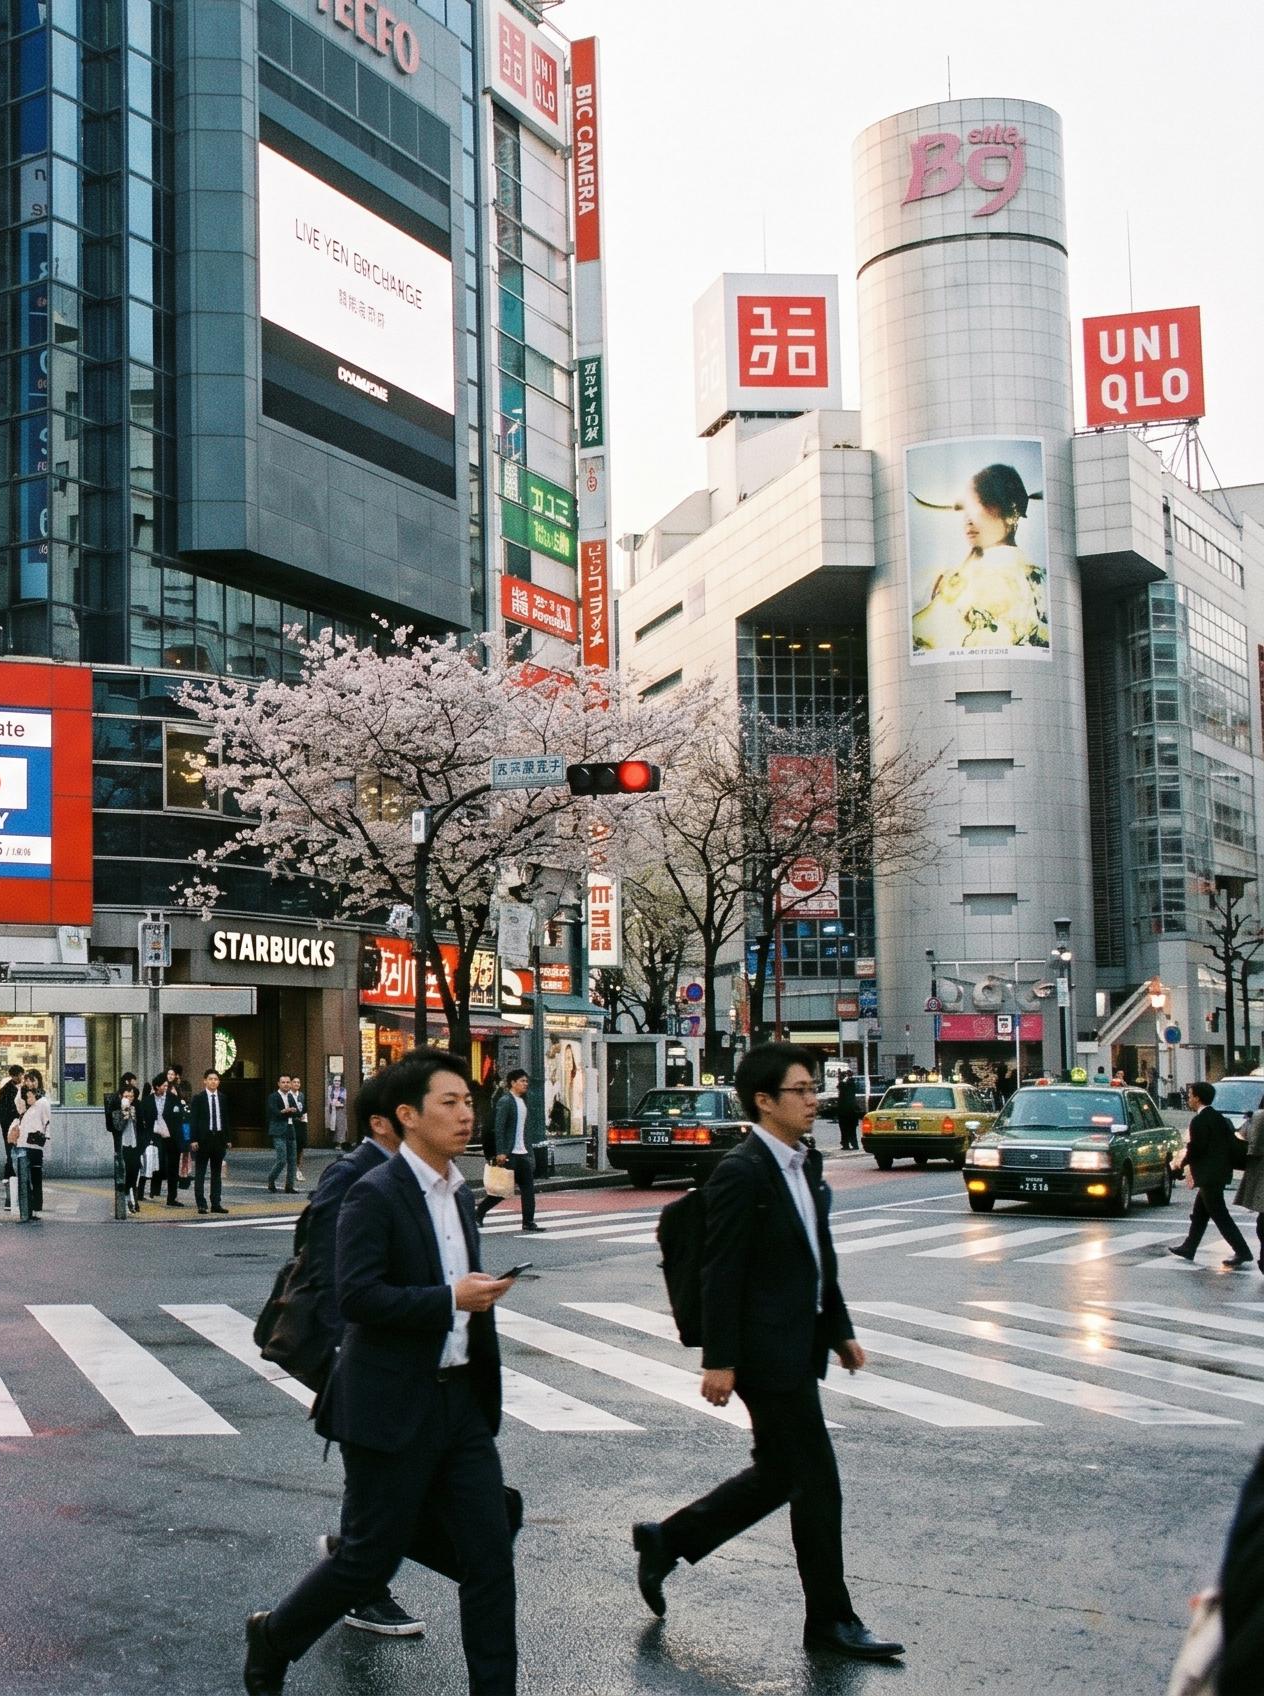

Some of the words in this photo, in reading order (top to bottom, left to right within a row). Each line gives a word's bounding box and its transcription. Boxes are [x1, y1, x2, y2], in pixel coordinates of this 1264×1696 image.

[575, 83, 593, 121] BIC
[576, 125, 596, 217] CAMERA
[296, 218, 320, 250] LIVE
[324, 233, 349, 267] YEN
[750, 306, 816, 337] ユニ
[748, 344, 817, 376] クロ
[1099, 323, 1180, 365] UNI
[1101, 367, 1189, 415] QLO
[213, 930, 336, 968] STARBUCKS
